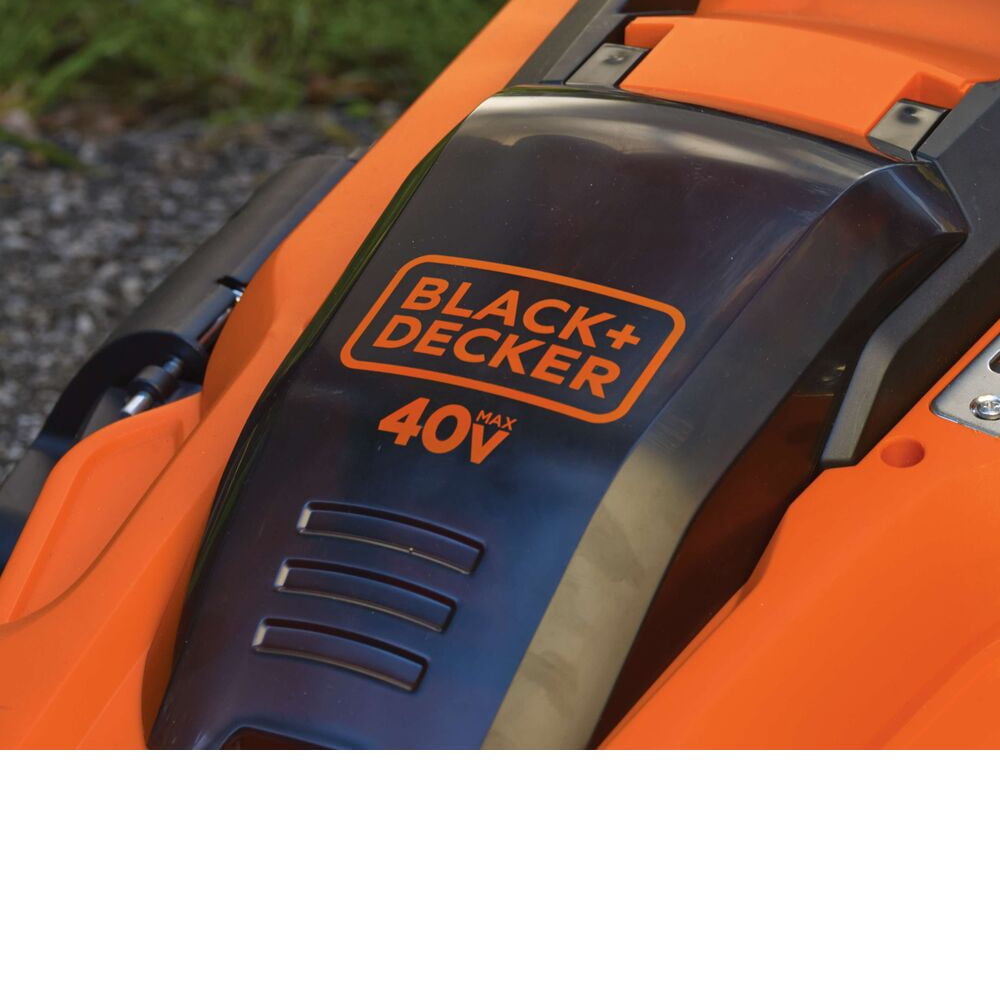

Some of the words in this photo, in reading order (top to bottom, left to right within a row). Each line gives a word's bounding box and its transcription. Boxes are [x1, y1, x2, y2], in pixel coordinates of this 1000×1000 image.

[401, 276, 641, 350] BLACK+
[372, 315, 621, 399] DECKER
[475, 409, 518, 431] MAX
